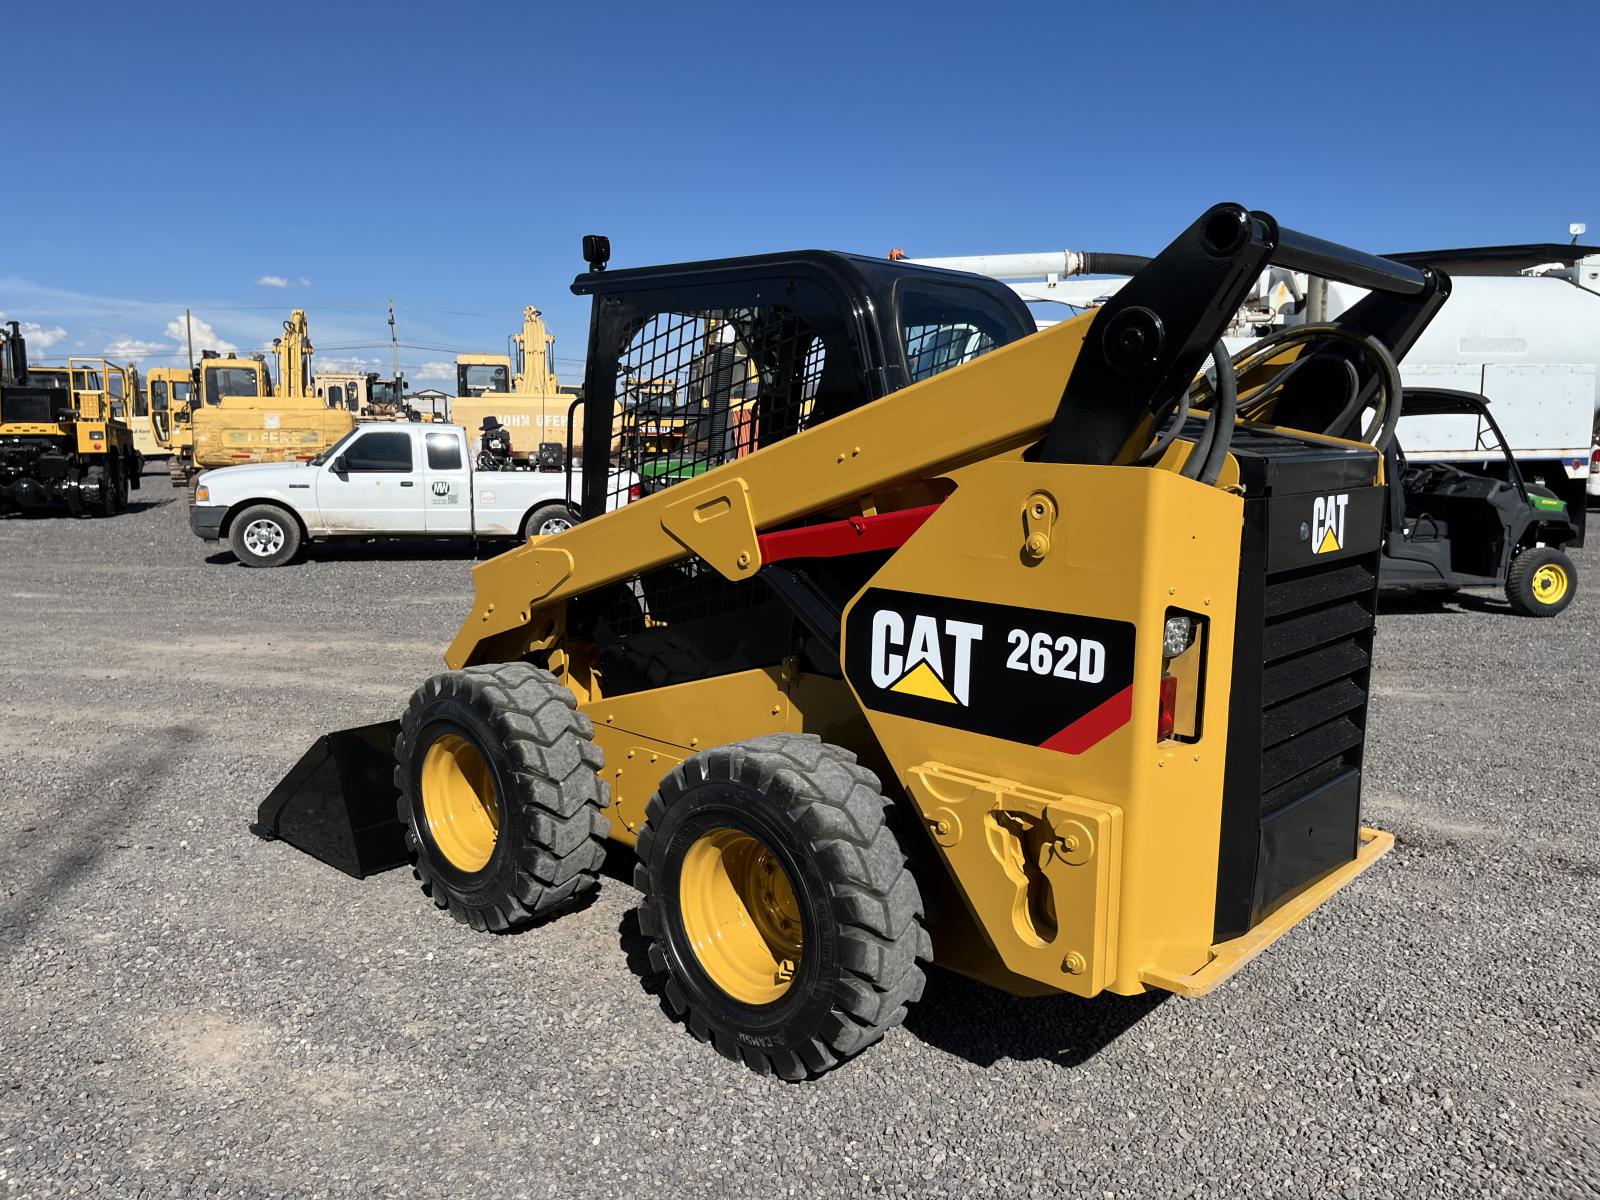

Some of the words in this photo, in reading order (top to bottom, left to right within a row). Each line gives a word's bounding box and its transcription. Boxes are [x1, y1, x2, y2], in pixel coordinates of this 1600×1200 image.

[1311, 494, 1349, 554] CAT
[870, 609, 983, 707] CAT
[1006, 628, 1106, 684] 262D
